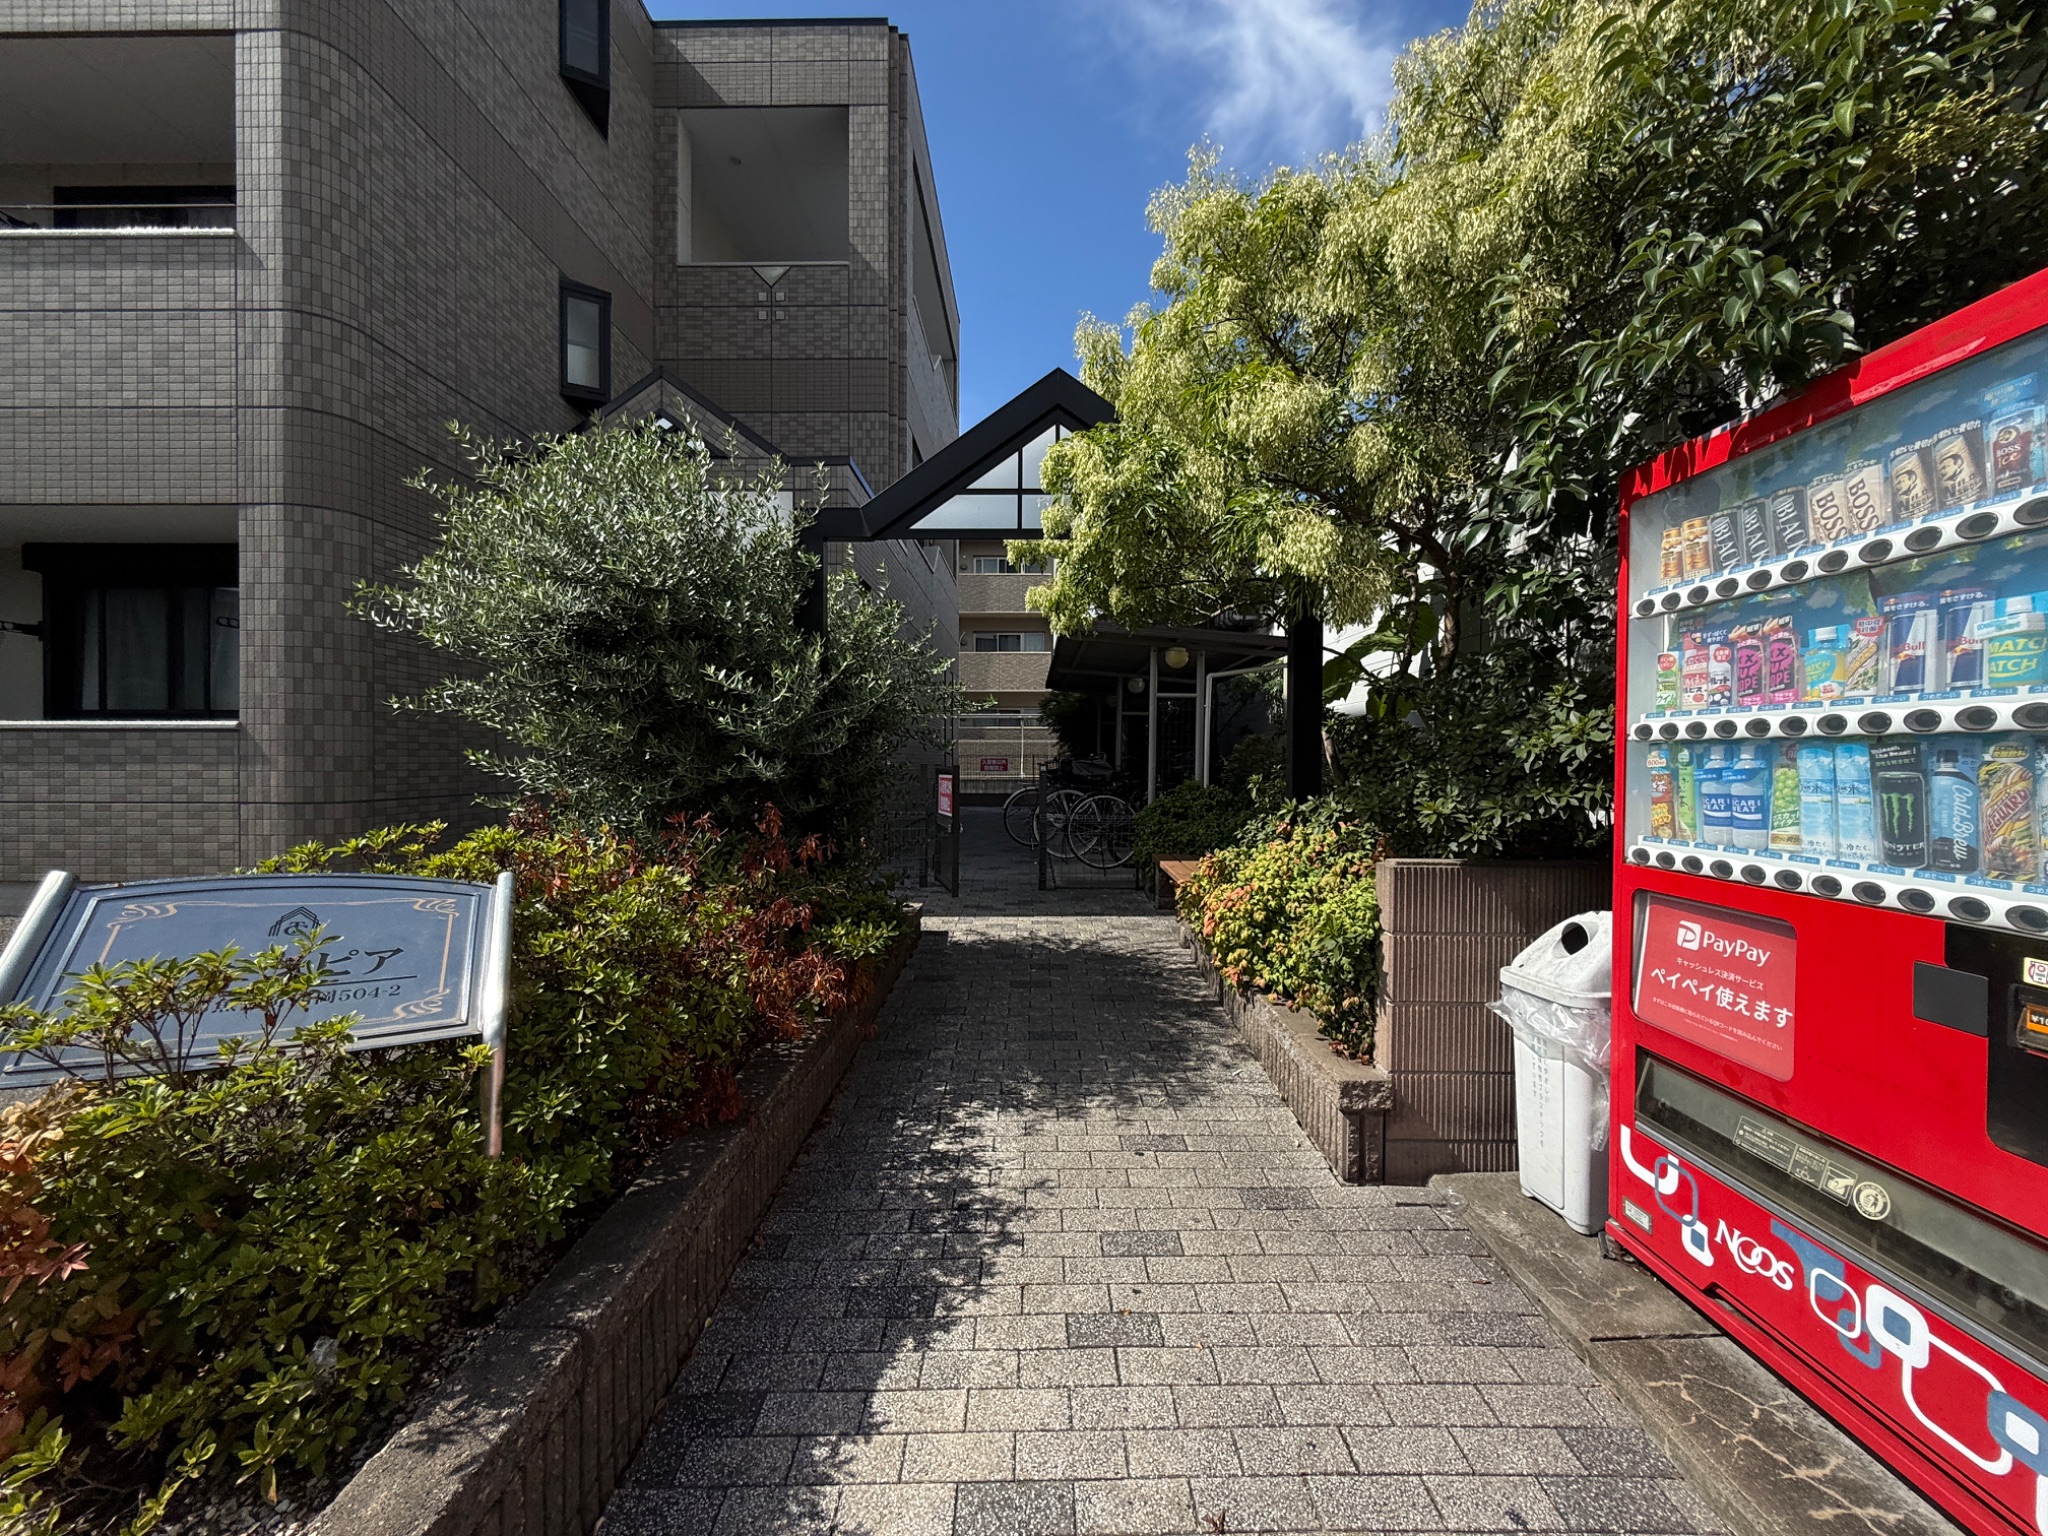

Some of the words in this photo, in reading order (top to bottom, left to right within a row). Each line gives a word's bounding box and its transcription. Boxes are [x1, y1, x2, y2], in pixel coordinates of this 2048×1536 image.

[1776, 496, 1809, 554] BLACK
[1816, 491, 1847, 541] BOSS
[1849, 478, 1880, 531] BOSS
[1714, 519, 1743, 573] BLACK
[1744, 507, 1771, 564] BLACK
[1989, 657, 2038, 672] ATCH
[316, 947, 405, 977] ピア
[1676, 957, 1764, 991] キャッシュレス決済サービス
[1703, 931, 1771, 967] PayPay
[1651, 967, 1793, 1028] ペイペイ使えます
[1714, 1217, 1795, 1291] NOOS
